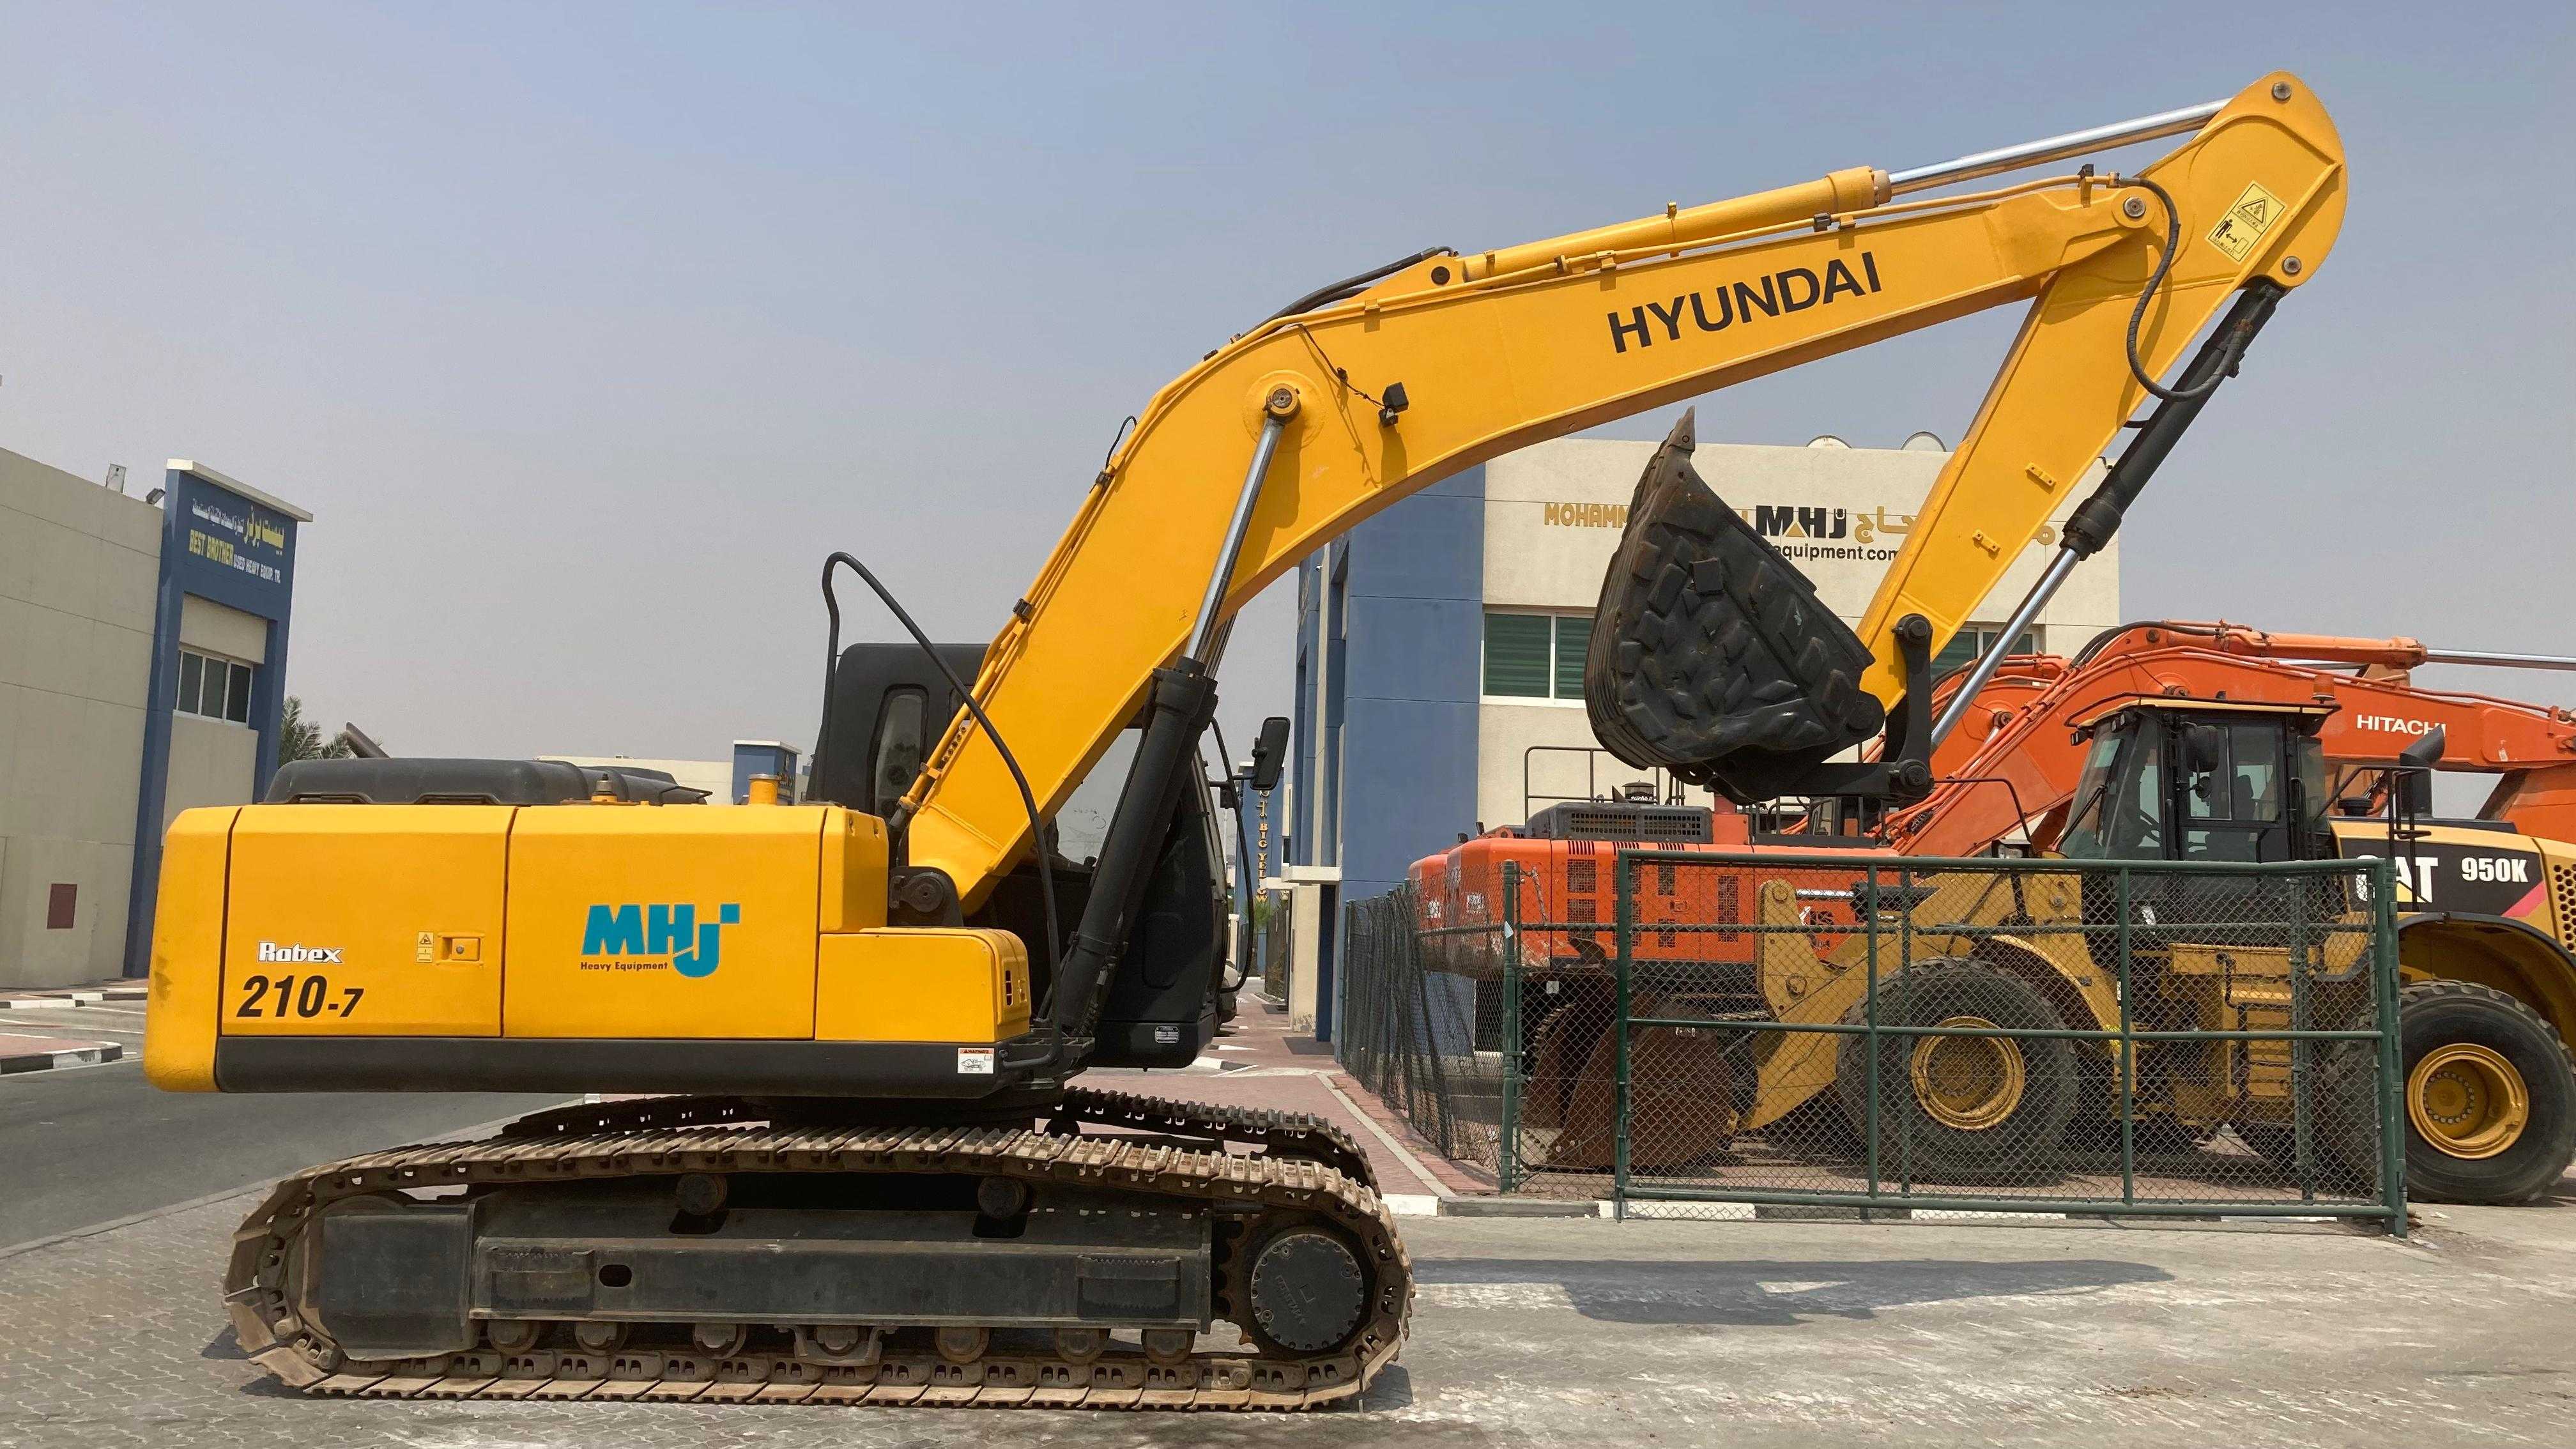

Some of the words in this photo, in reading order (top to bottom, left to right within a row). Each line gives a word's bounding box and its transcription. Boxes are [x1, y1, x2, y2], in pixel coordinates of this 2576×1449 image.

[1607, 252, 1882, 353] HYUNDAI
[1544, 502, 1629, 528] MOHAMM
[1756, 505, 1846, 538] MHJ
[189, 529, 206, 556] BEST
[206, 535, 234, 567] BROTHER
[233, 554, 246, 571] USED
[246, 558, 261, 576] HEAVY
[2357, 714, 2446, 737] HITACHI
[1258, 822, 1268, 848] BIG
[1255, 853, 1268, 903] YELOW
[2462, 857, 2529, 883] 950K
[258, 940, 344, 963] Robex
[581, 904, 739, 977] MHJ
[580, 962, 611, 971] Heavy
[615, 962, 668, 971] Equipment
[236, 975, 364, 1018] 210-7
